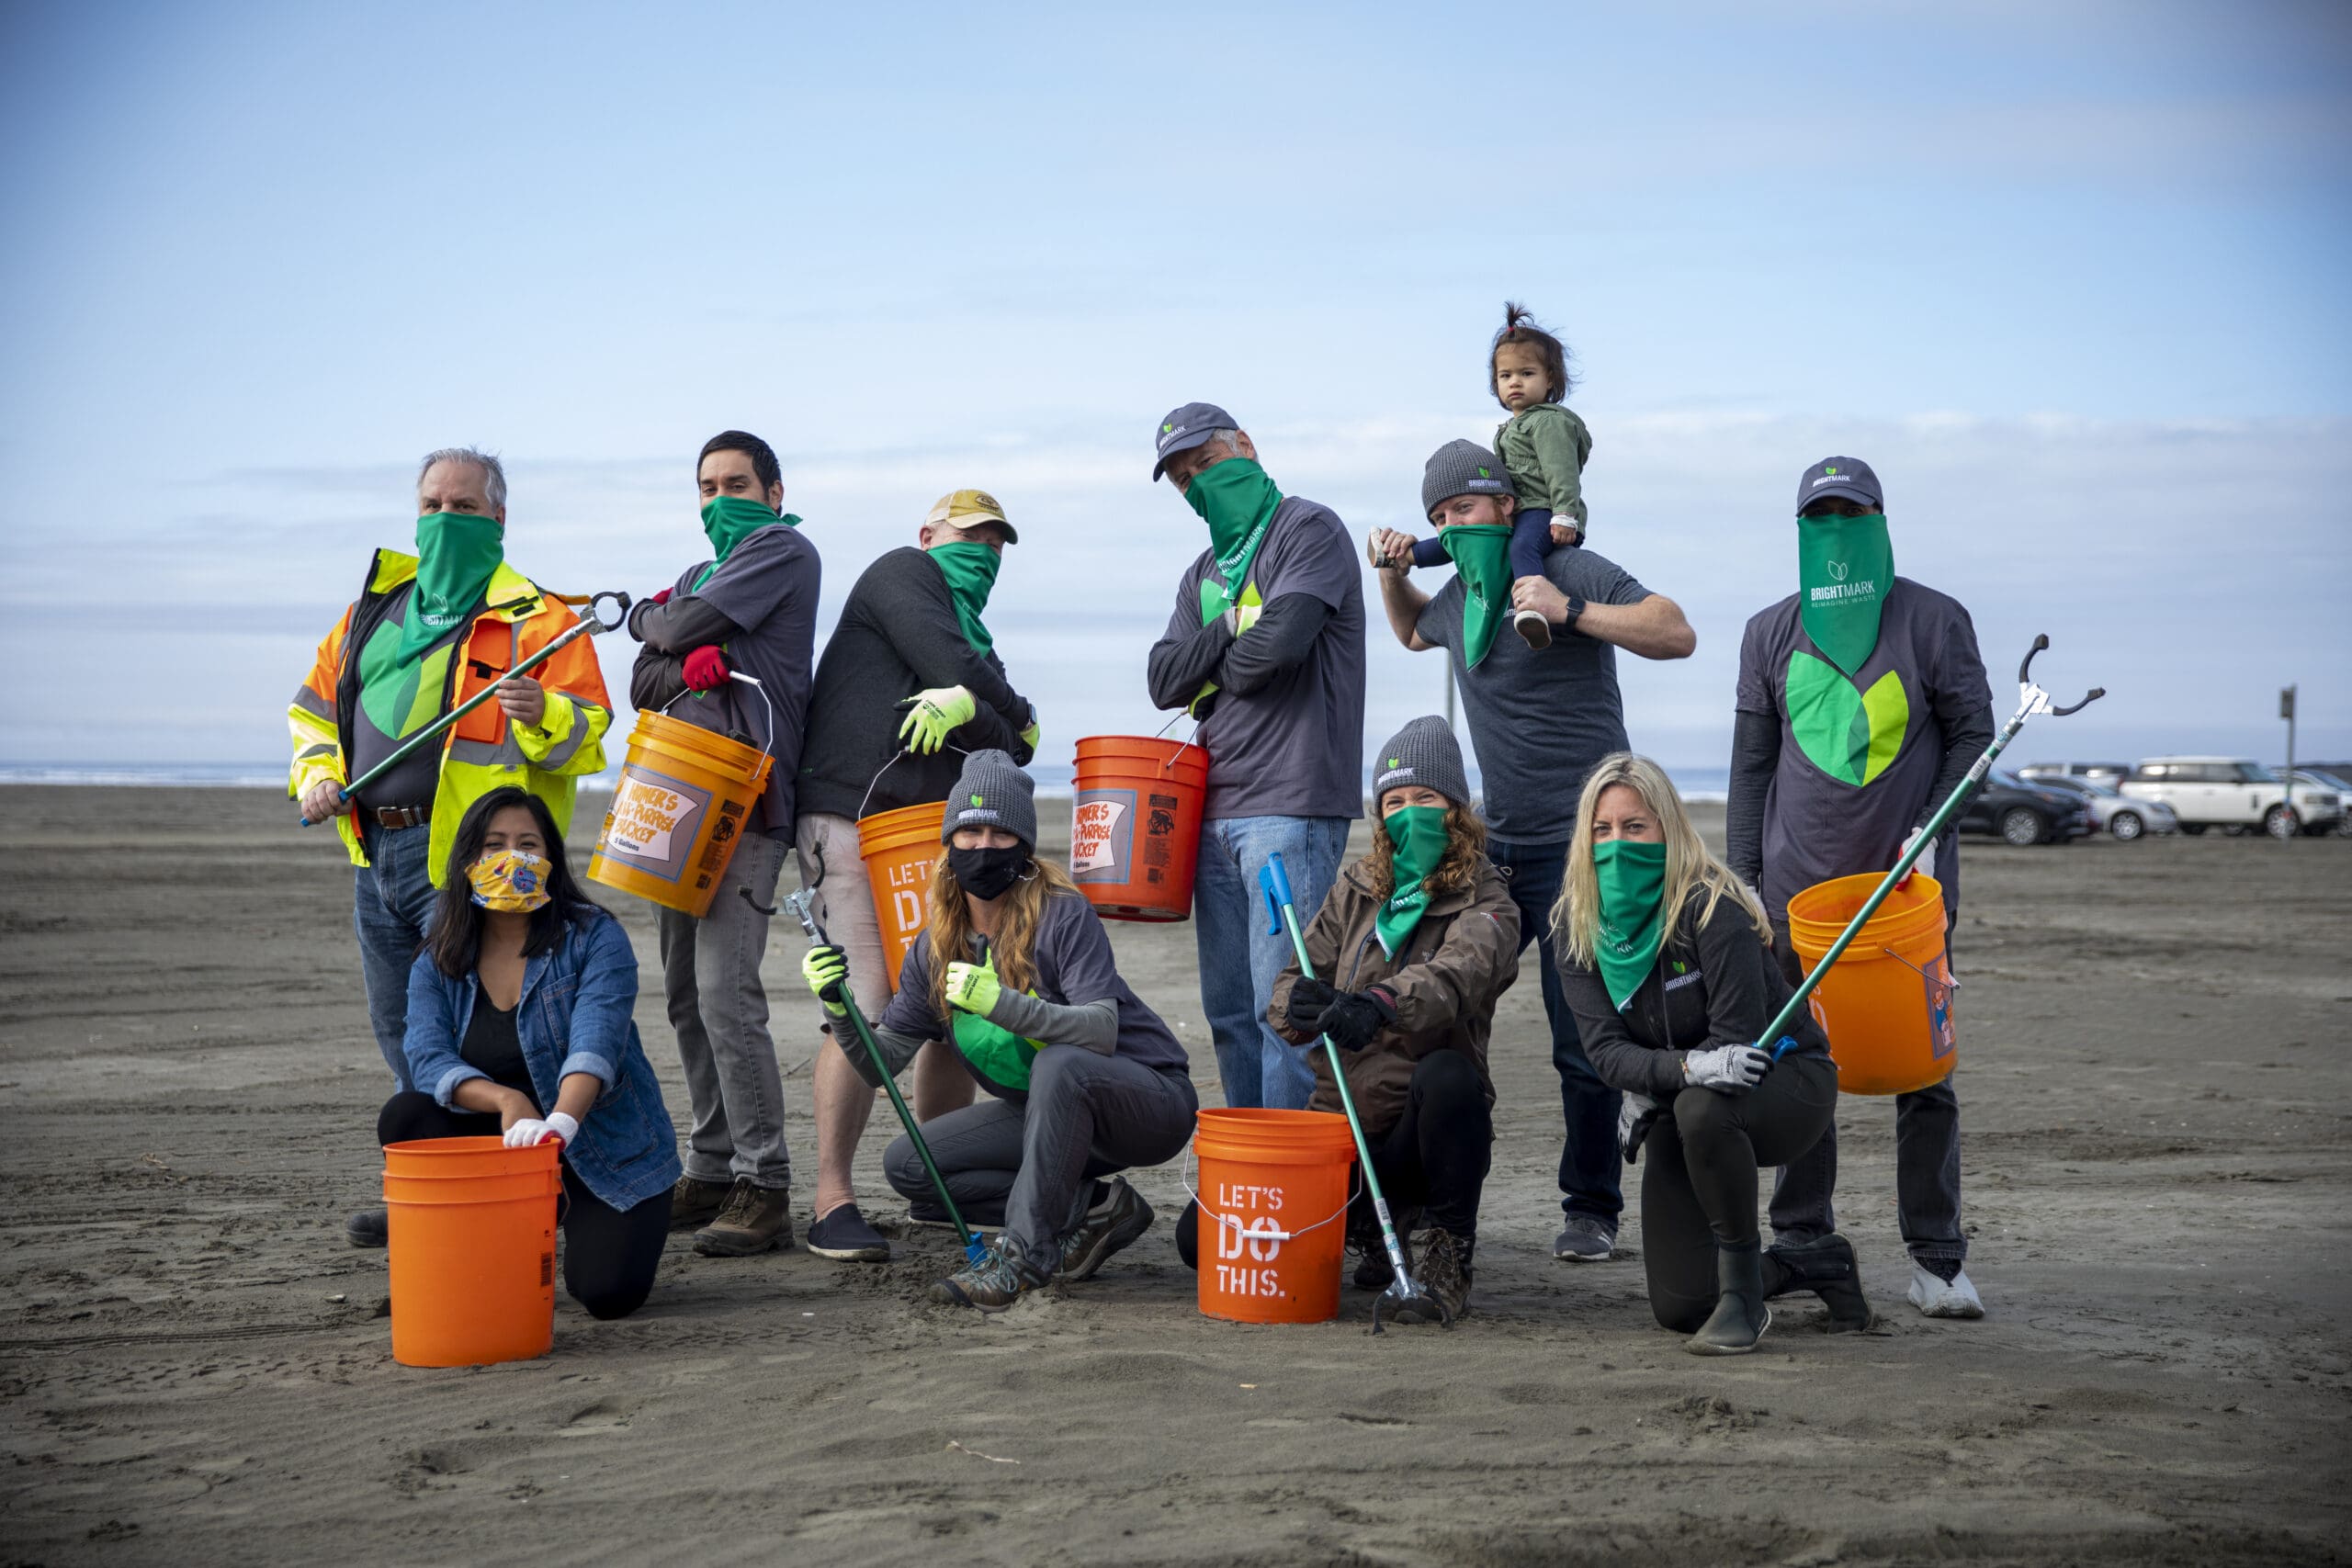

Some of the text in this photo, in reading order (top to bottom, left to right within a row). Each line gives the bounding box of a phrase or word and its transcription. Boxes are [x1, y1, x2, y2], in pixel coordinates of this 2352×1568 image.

[1811, 580, 1875, 602] BRIGHTMARK
[629, 782, 678, 811] HOMER'S
[615, 818, 658, 844] BUCKET
[1073, 841, 1100, 858] UCKET
[888, 859, 935, 887] LET'
[1219, 1182, 1284, 1211] LET'S
[1218, 1213, 1281, 1262] DO
[1216, 1264, 1286, 1298] THIS.
